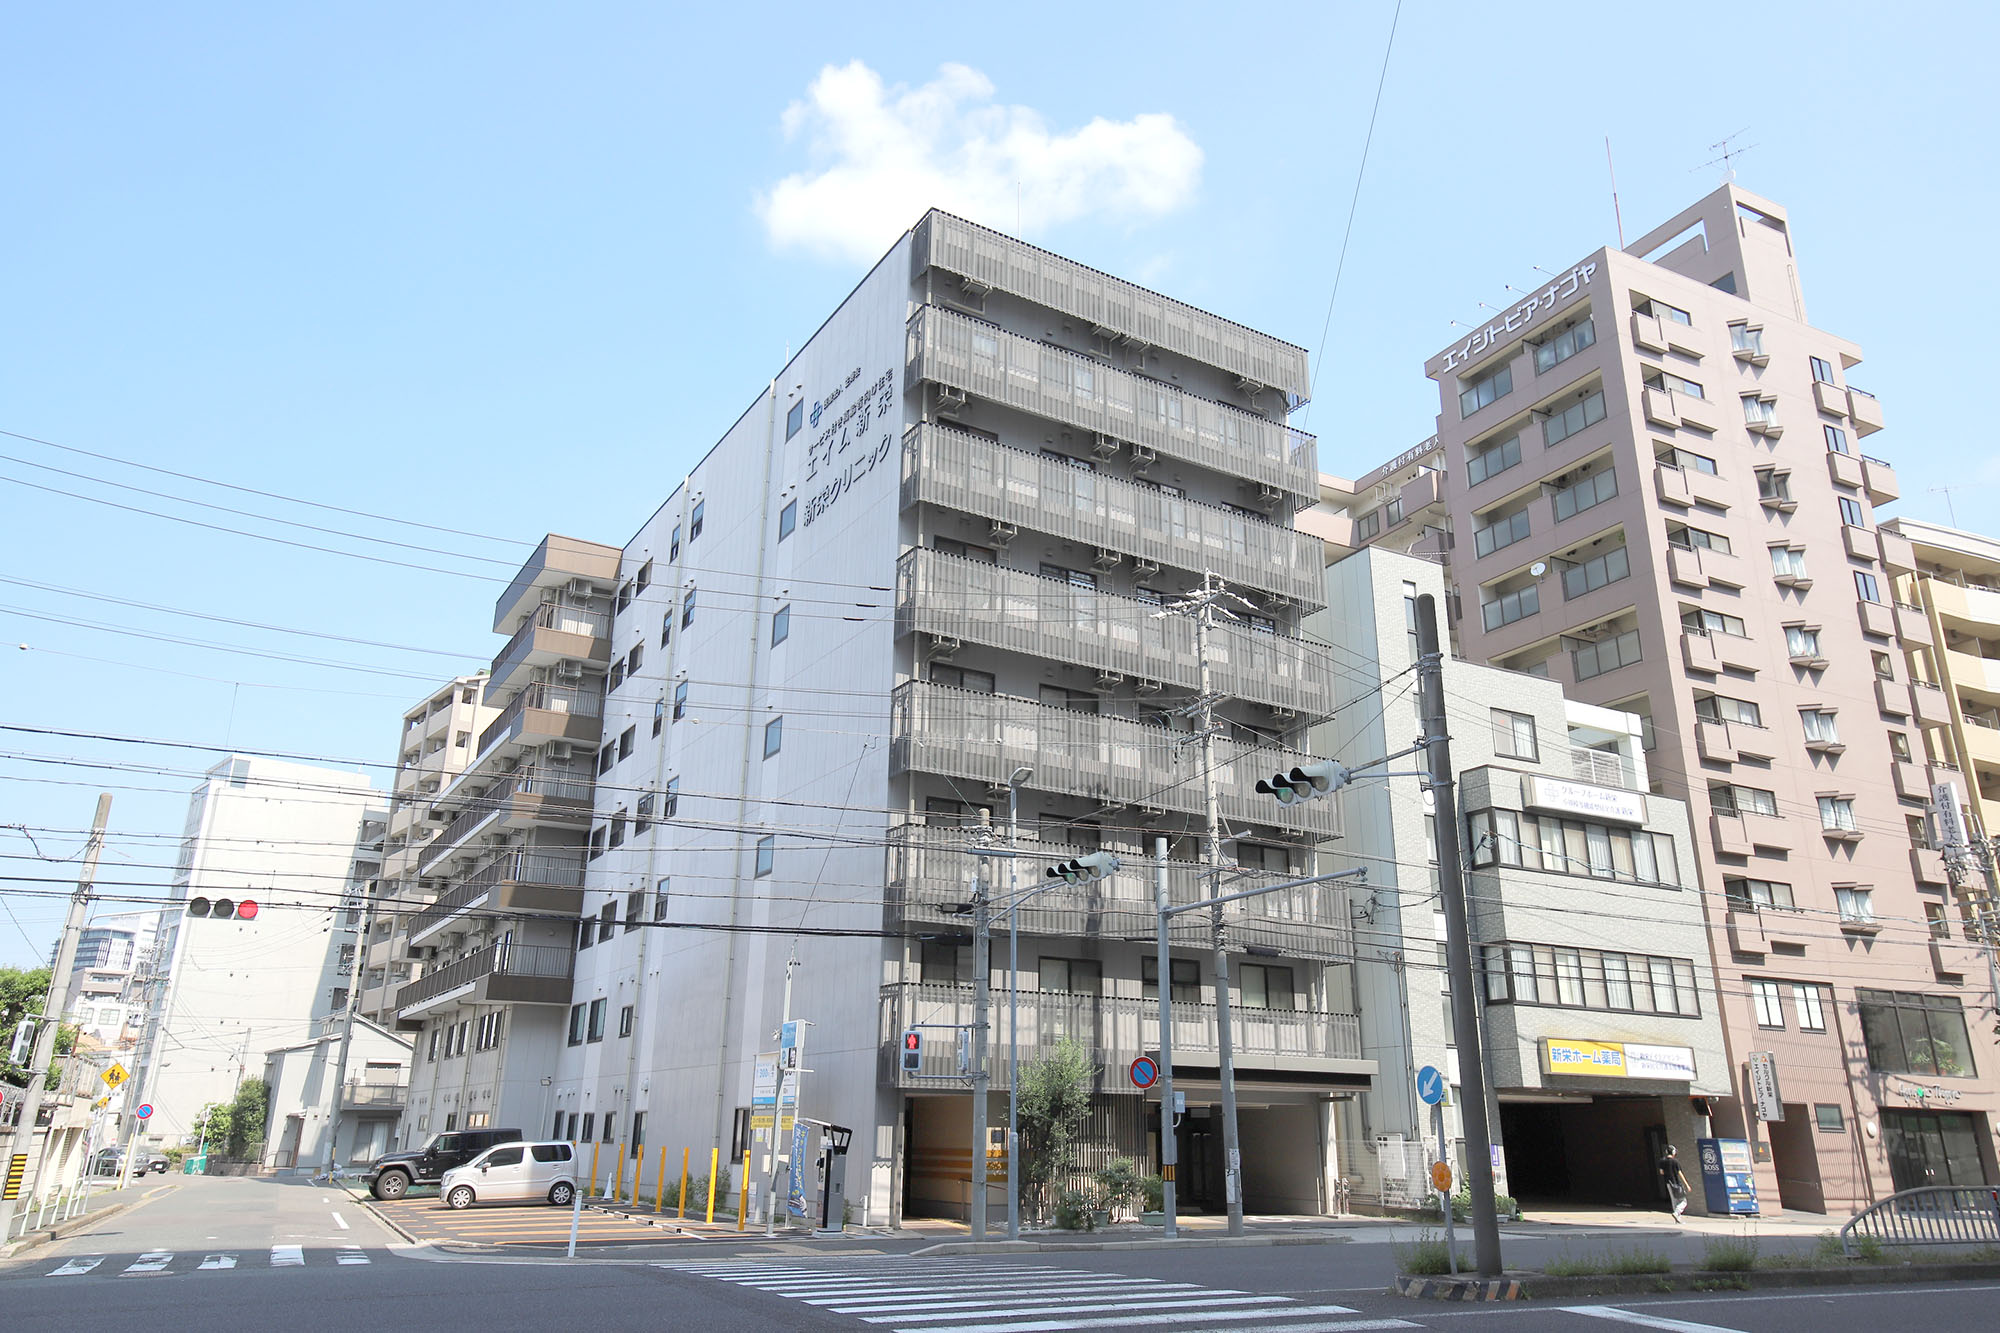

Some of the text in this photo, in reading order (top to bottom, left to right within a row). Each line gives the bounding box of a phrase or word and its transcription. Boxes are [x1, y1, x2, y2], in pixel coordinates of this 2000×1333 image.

[1442, 261, 1597, 374] エイジトピア・ナゴヤ
[806, 384, 893, 482] エイム新栄
[803, 433, 893, 528] 新栄クリニック
[1937, 785, 1960, 845] 介護付有料老人
[1551, 1047, 1622, 1067] 新栄ホーム薬局
[1703, 1164, 1720, 1172] BOSS
